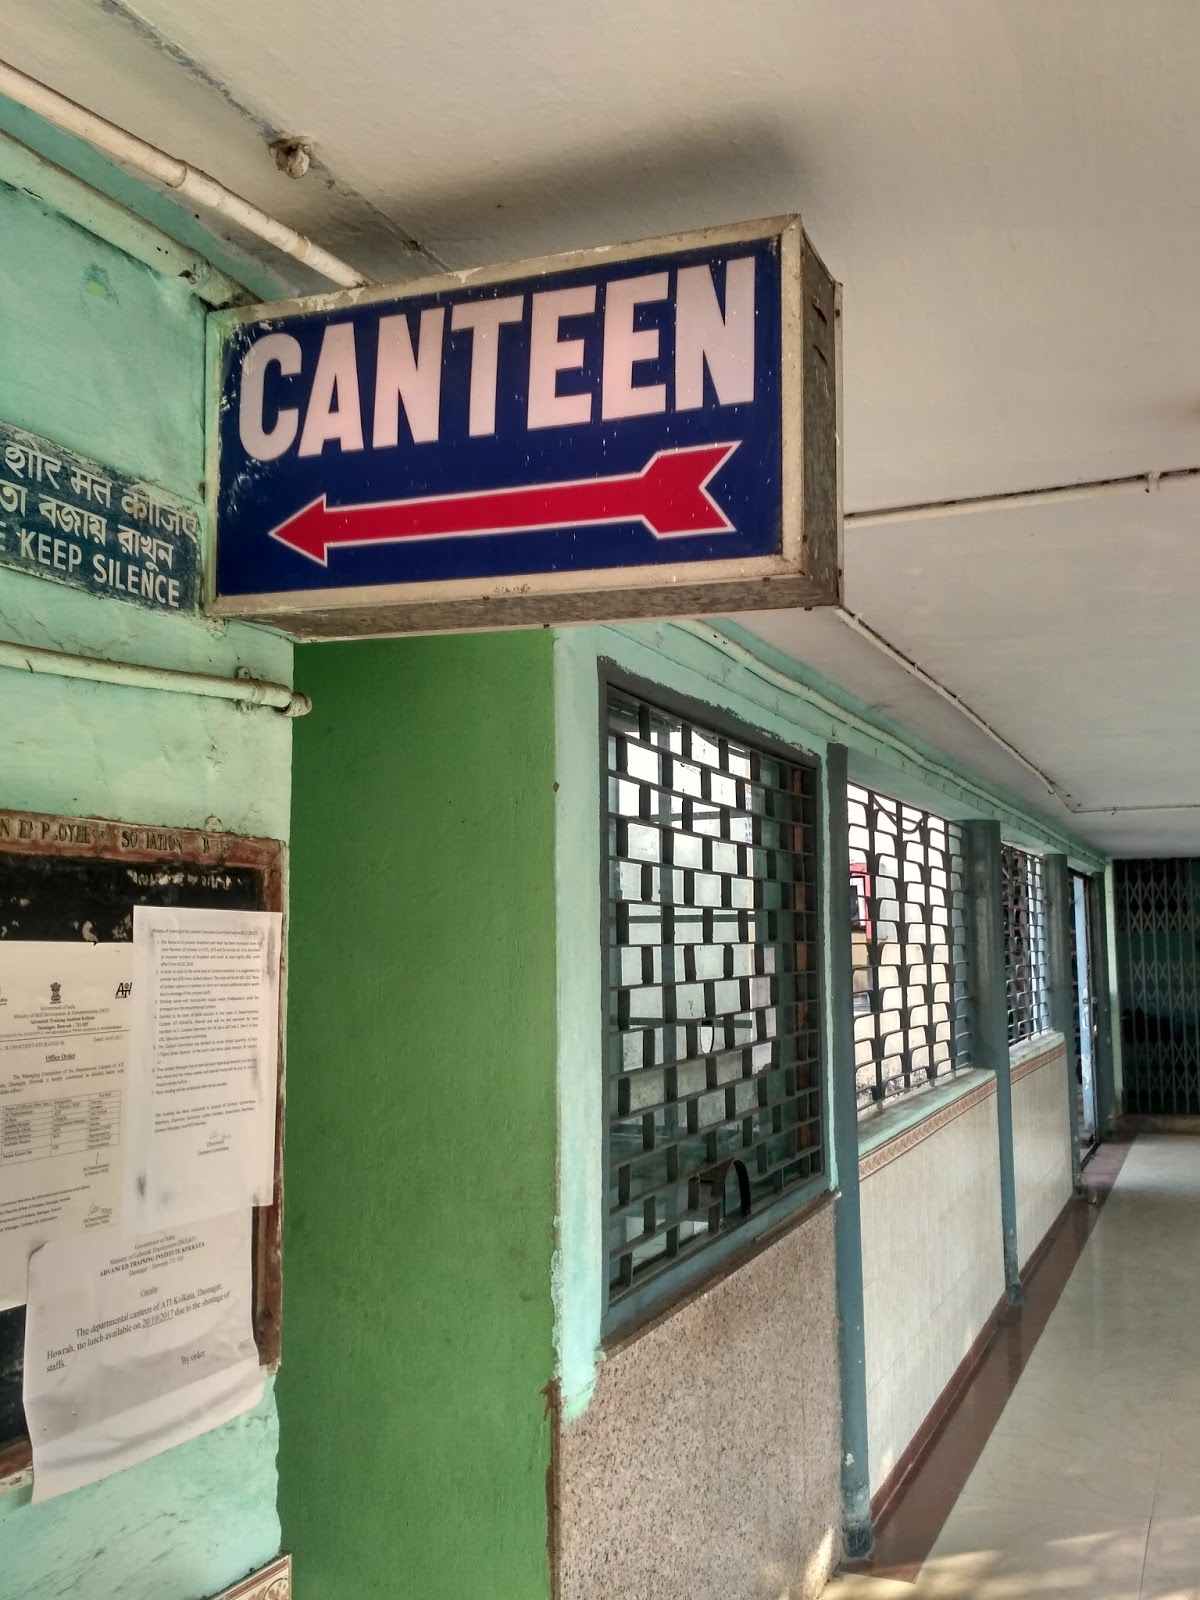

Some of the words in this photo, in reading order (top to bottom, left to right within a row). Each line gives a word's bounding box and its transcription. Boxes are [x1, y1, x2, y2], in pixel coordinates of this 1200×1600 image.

[238, 256, 756, 461] CANTEEN
[71, 466, 112, 509] मत
[38, 493, 107, 547] বজায়
[118, 523, 174, 573] রাখুন
[20, 528, 83, 573] KEEP
[93, 554, 180, 608] SILENCE
[100, 1262, 129, 1277] ADVANCED
[130, 1257, 155, 1268] TRAINING
[155, 1249, 180, 1260] INSTITUTE
[181, 1242, 205, 1252] KOLKATA
[47, 1344, 75, 1360] Howrah,
[76, 1341, 87, 1351] no
[87, 1334, 104, 1347] lunch
[105, 1324, 132, 1340] available
[133, 1322, 141, 1330] on
[141, 1310, 174, 1329] 20/10/2017
[174, 1307, 185, 1316] due
[186, 1304, 192, 1312] to
[192, 1301, 201, 1310] the
[202, 1293, 224, 1307] shortage
[224, 1289, 231, 1299] of
[75, 1327, 90, 1338] The
[90, 1312, 129, 1333] departmental
[129, 1306, 152, 1320] canteen
[153, 1301, 161, 1312] of
[160, 1298, 173, 1310] ATI
[46, 1359, 67, 1373] staffs.
[180, 1355, 190, 1365] By
[190, 1350, 206, 1361] order
